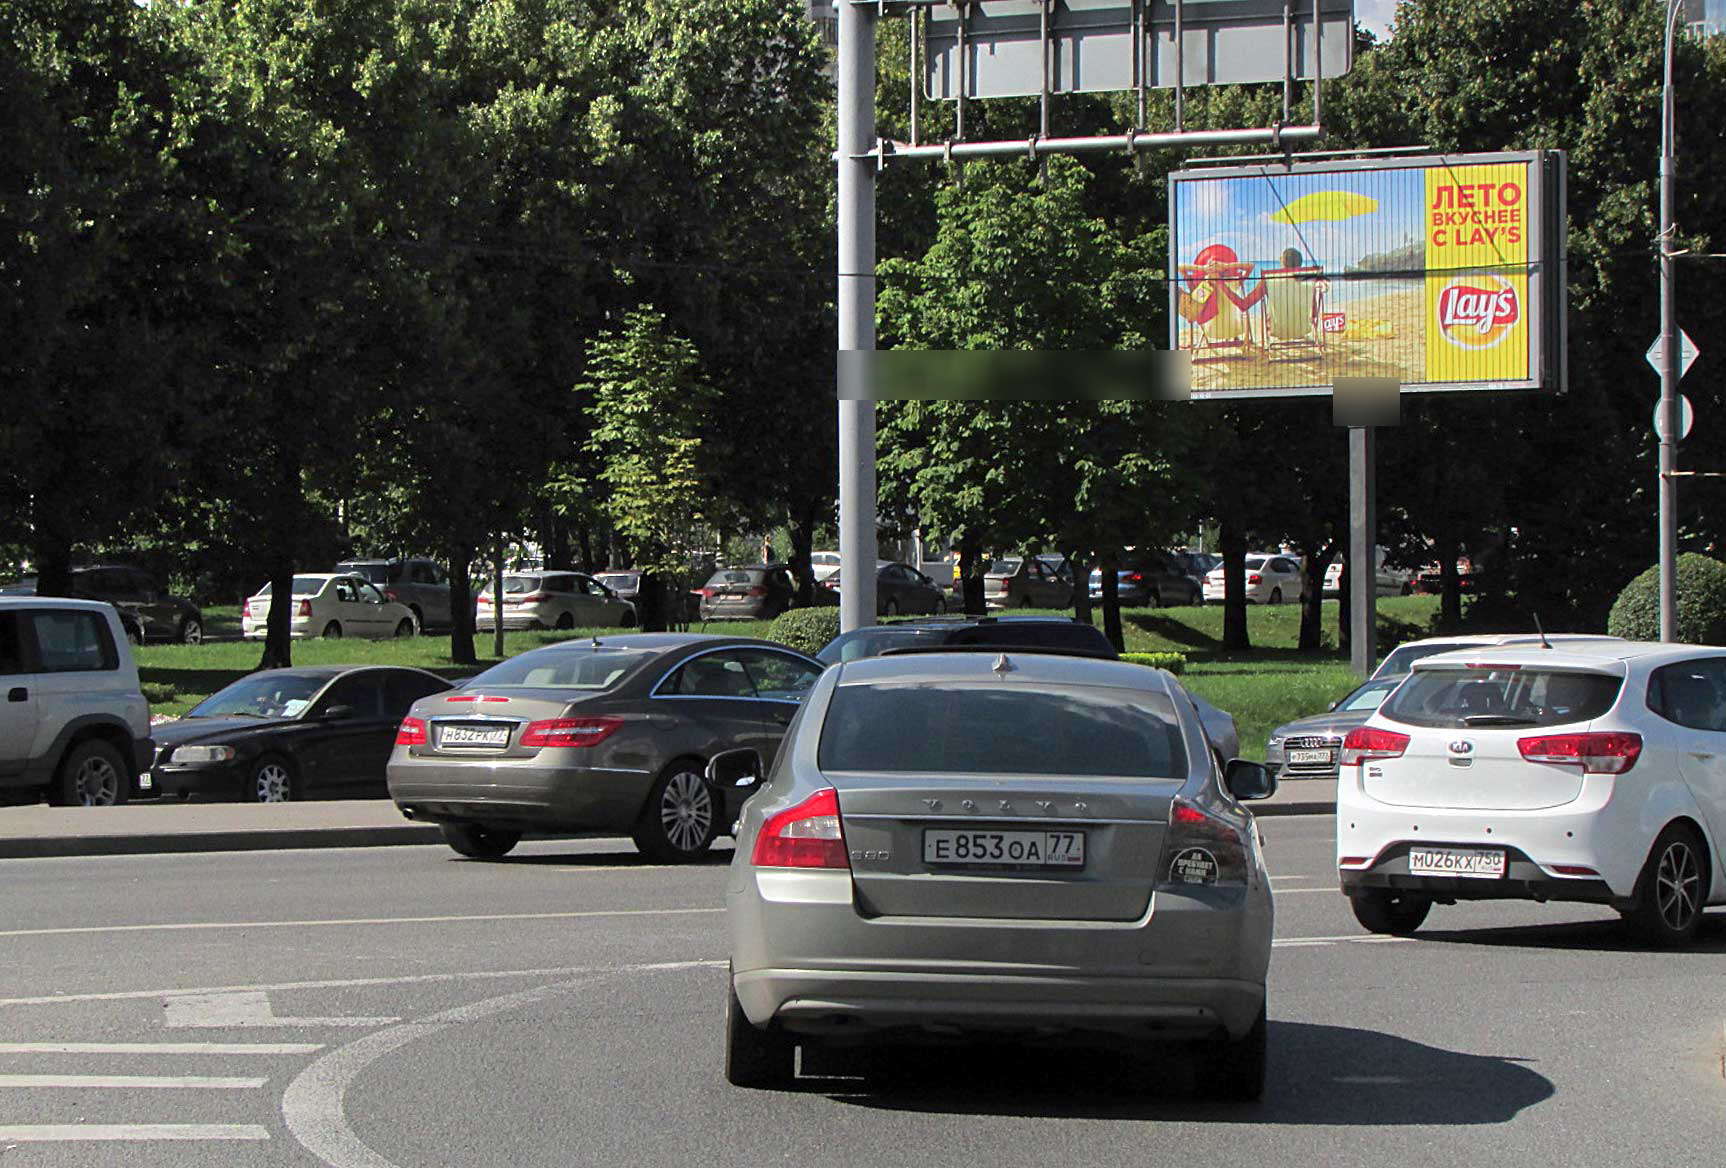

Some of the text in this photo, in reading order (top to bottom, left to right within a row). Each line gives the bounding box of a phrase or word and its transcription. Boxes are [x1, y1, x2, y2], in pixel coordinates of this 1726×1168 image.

[1432, 182, 1521, 210] ЛЕТО
[1433, 208, 1521, 226] ВКУСНЕЕ
[1455, 226, 1521, 247] LAY'S
[1451, 742, 1469, 751] KIA
